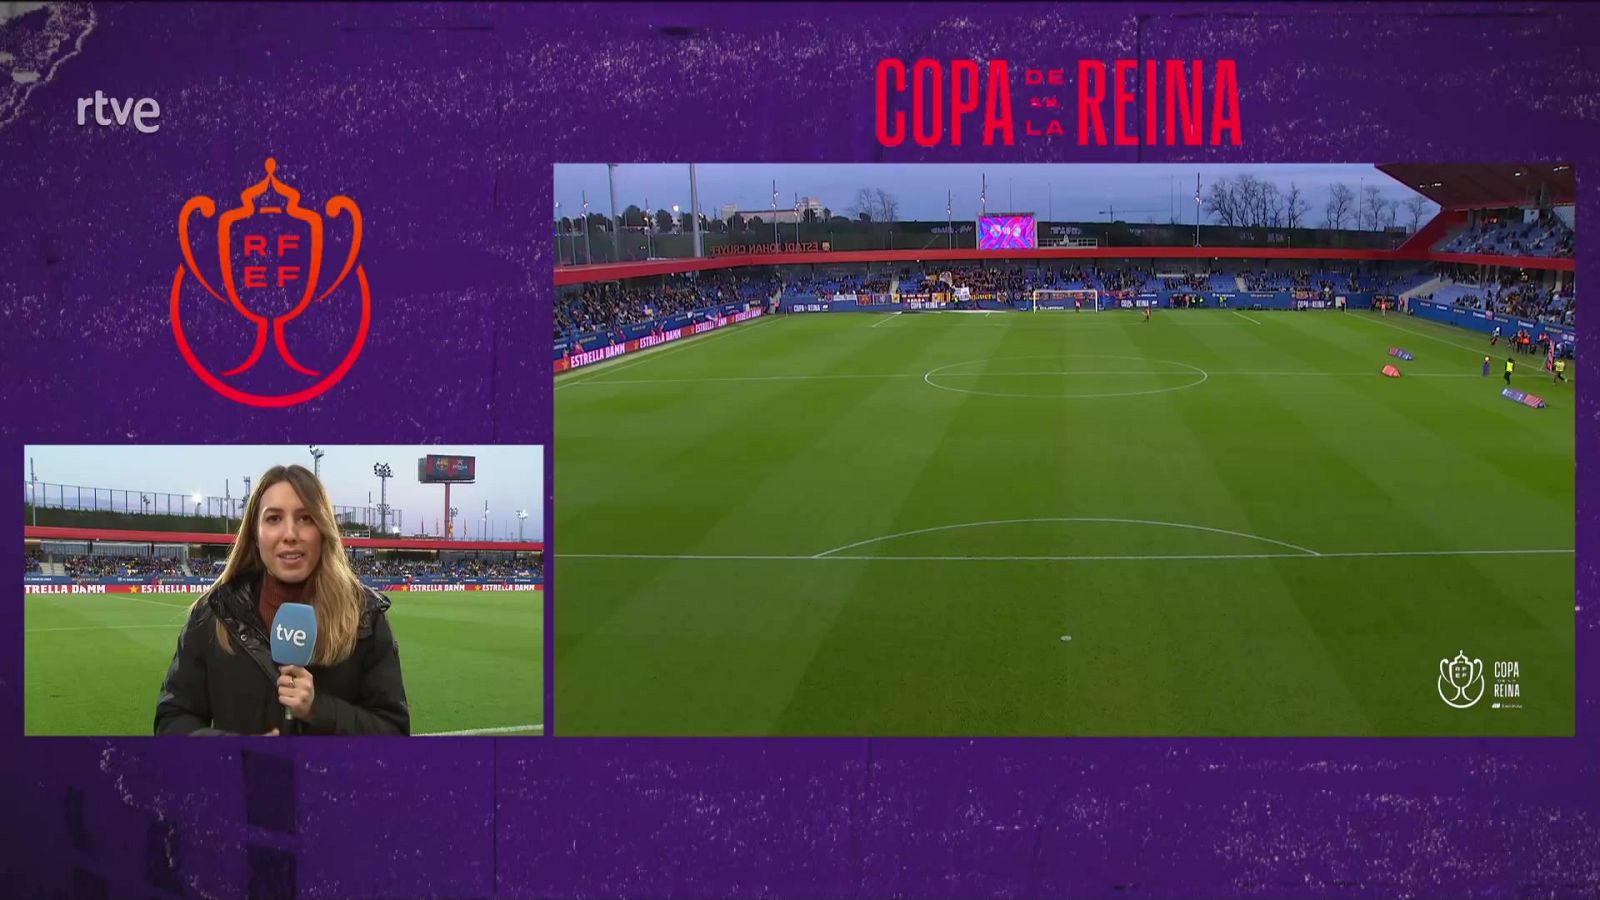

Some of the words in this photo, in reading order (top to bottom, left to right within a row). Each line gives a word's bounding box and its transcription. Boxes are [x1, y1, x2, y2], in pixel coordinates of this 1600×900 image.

[665, 328, 681, 342] DAMM
[570, 348, 604, 368] ESTRELLA
[605, 343, 626, 358] DAMM
[71, 584, 106, 594] DAMM
[141, 584, 187, 593] ESTRELLA
[189, 584, 211, 593] DAM
[409, 584, 442, 592] ESTRELLA
[276, 623, 307, 647] tve
